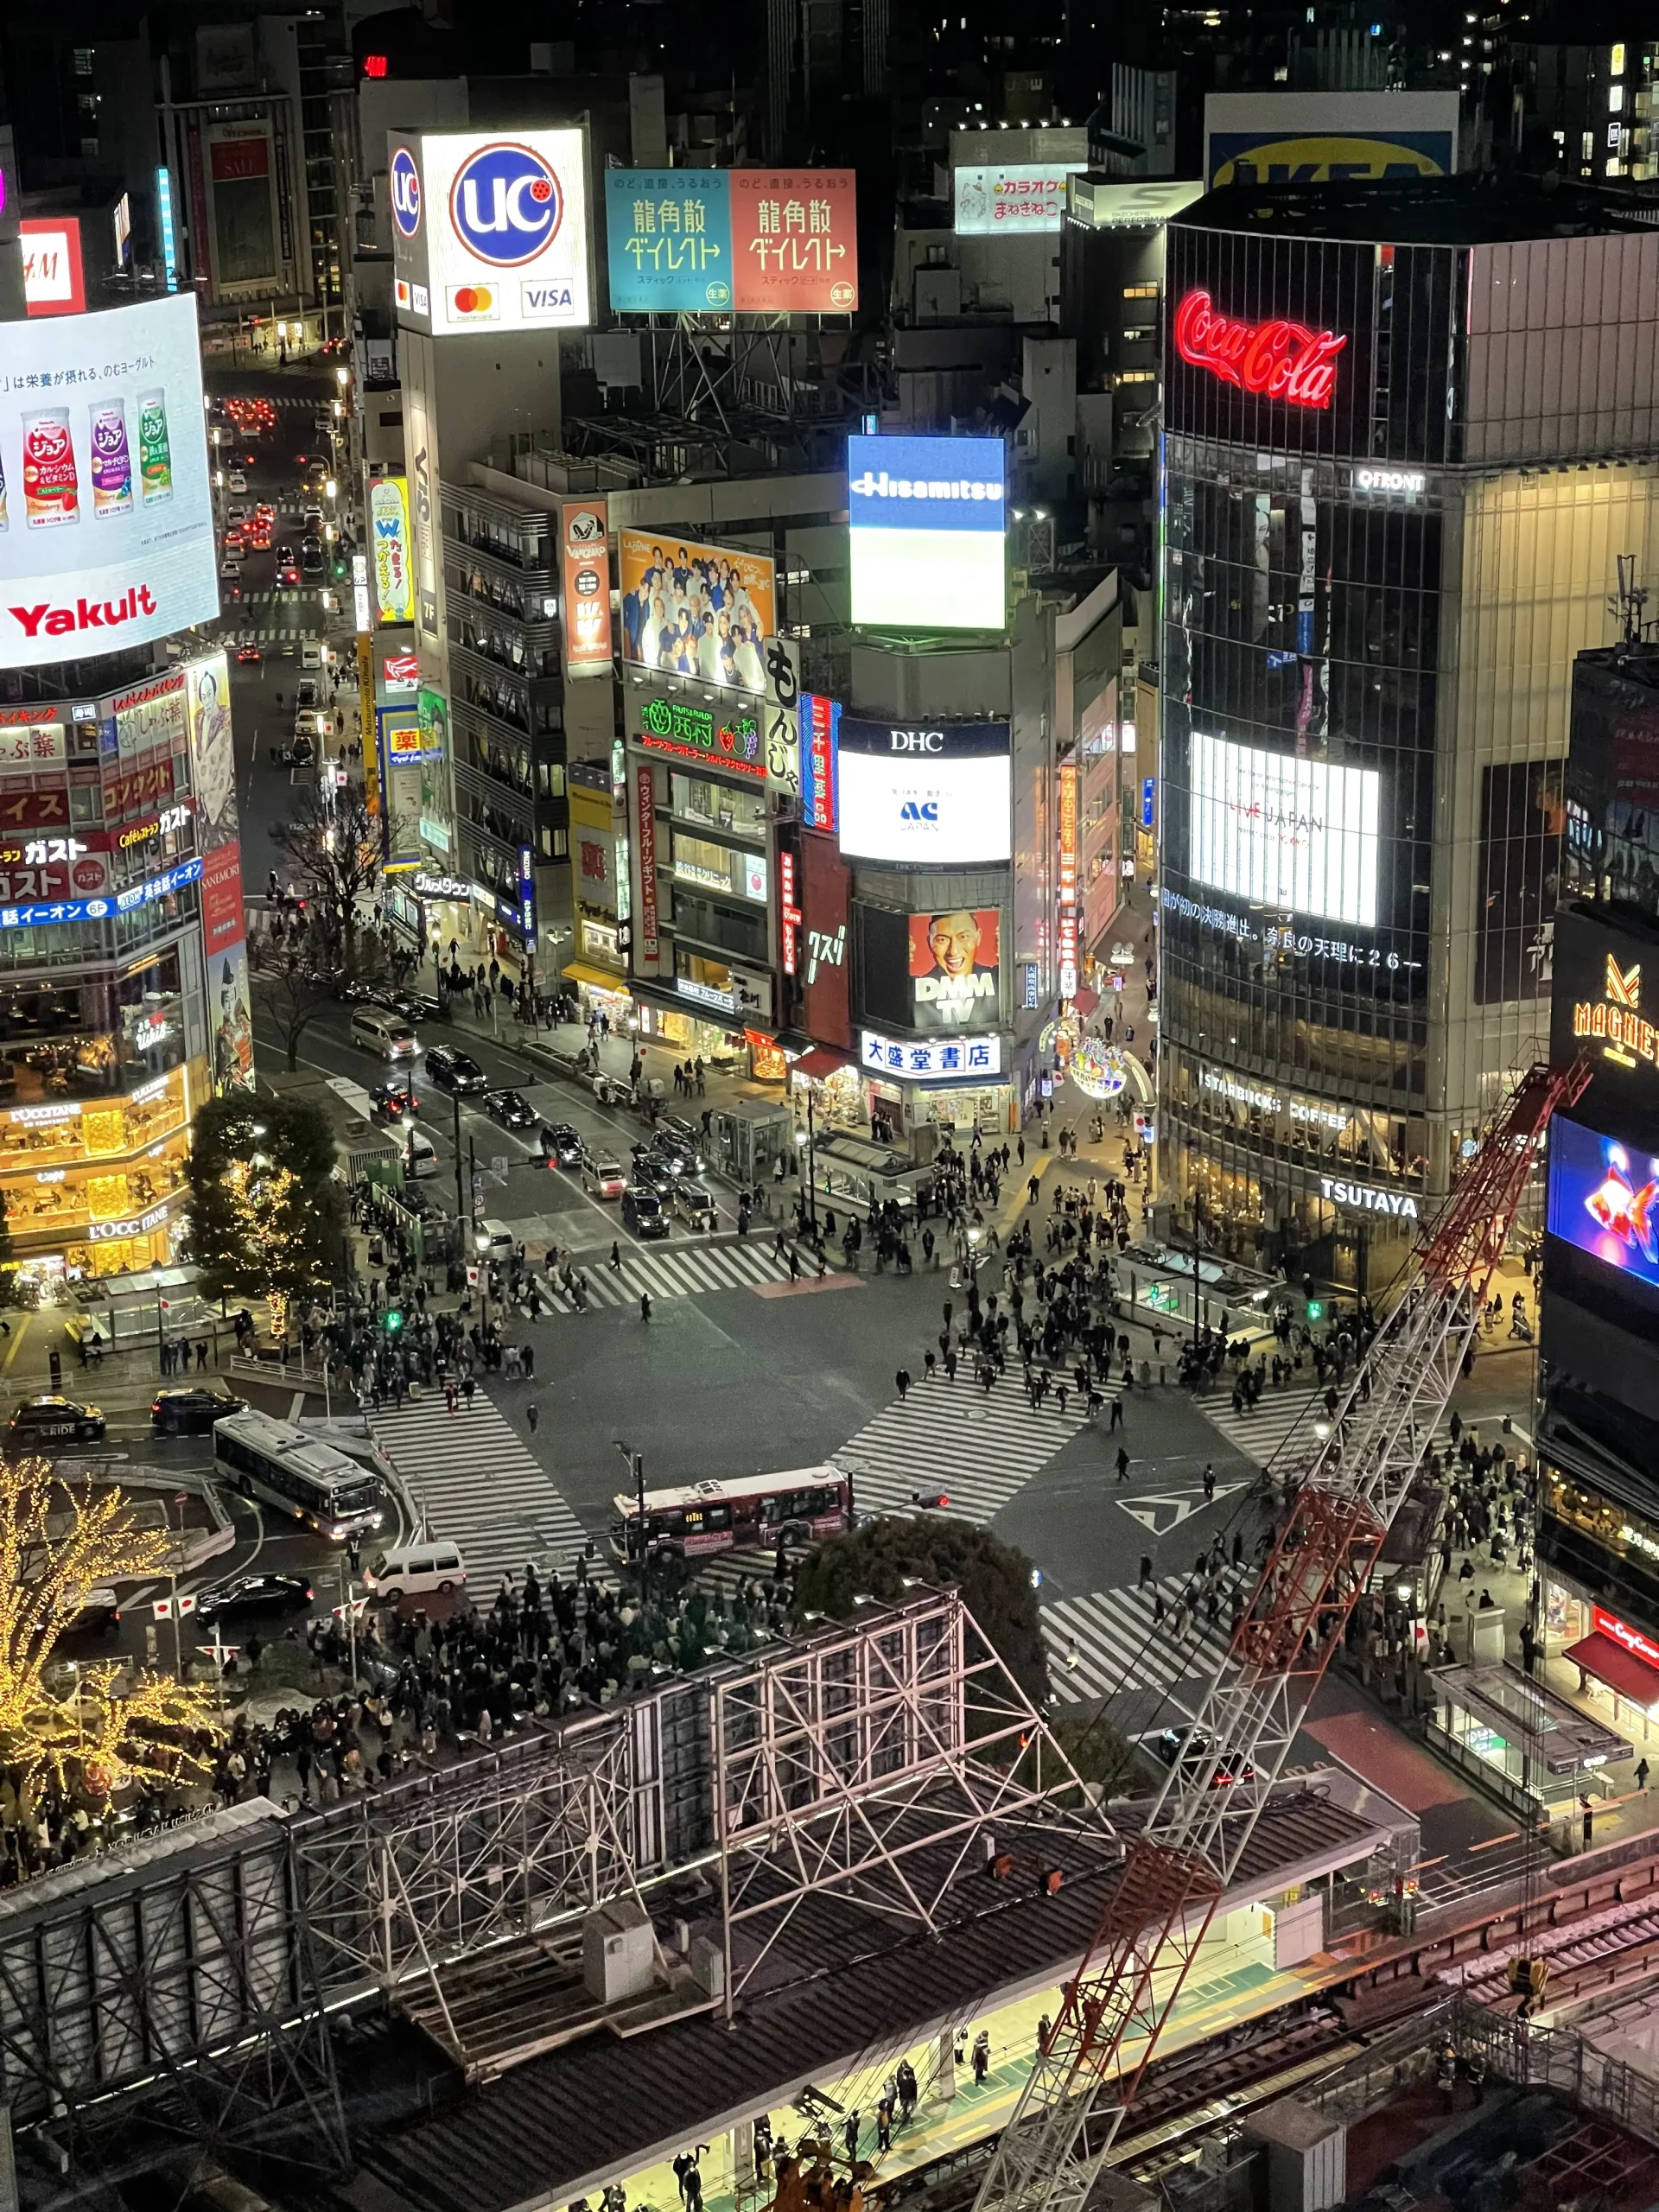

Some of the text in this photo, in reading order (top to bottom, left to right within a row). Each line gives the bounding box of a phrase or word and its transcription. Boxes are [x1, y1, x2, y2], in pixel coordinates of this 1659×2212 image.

[1003, 180, 1059, 194] カラオケ
[463, 175, 551, 233] UC
[633, 200, 706, 233] 龍角散
[759, 200, 832, 233] 龍角散
[995, 200, 1058, 219] まねきねこ
[625, 238, 721, 270] ダイレクト
[749, 238, 846, 270] ダイレクト
[638, 276, 674, 285] スティック
[708, 289, 728, 300] 生薬
[762, 276, 799, 285] スティック
[832, 289, 853, 300] 生薬
[415, 292, 428, 308] VISA
[524, 289, 572, 308] VISA
[1176, 290, 1347, 410] Coca-Cola
[0, 355, 155, 392] 」は栄養が摂れる、のむヨーグルト
[98, 429, 122, 448] ジョア
[144, 418, 163, 436] ジョア
[33, 439, 66, 458] ジョア
[40, 465, 74, 474] カルシウム
[1359, 470, 1426, 492] QFRONT
[851, 472, 1001, 500] Hisamitsu
[8, 583, 157, 638] Yakult
[423, 601, 435, 620] 7F
[364, 689, 375, 736] Matsumoto
[767, 641, 799, 793] もんじゃ
[395, 730, 417, 751] 薬
[673, 715, 713, 747] 西村
[891, 731, 944, 752] DHC
[812, 705, 828, 824] 三千里薬品
[104, 766, 170, 811] コンタクト
[159, 804, 191, 836] ガスト
[900, 802, 938, 821] AC
[1230, 798, 1323, 833] LIVE JAPAN
[25, 838, 88, 866] ガスト
[639, 784, 655, 896] ウィンターフルーツギフト
[119, 863, 201, 911] AEON 英会話イーオン
[415, 873, 471, 897] グルメタウン
[89, 904, 105, 914] 6F
[807, 925, 846, 985] クスリ
[915, 973, 995, 1002] DMM
[936, 998, 976, 1025] TV
[868, 1039, 990, 1071] 大盛堂書店
[1205, 1074, 1347, 1130] STARBUCKS COFFEE
[1320, 1179, 1418, 1218] TSUTAYA
